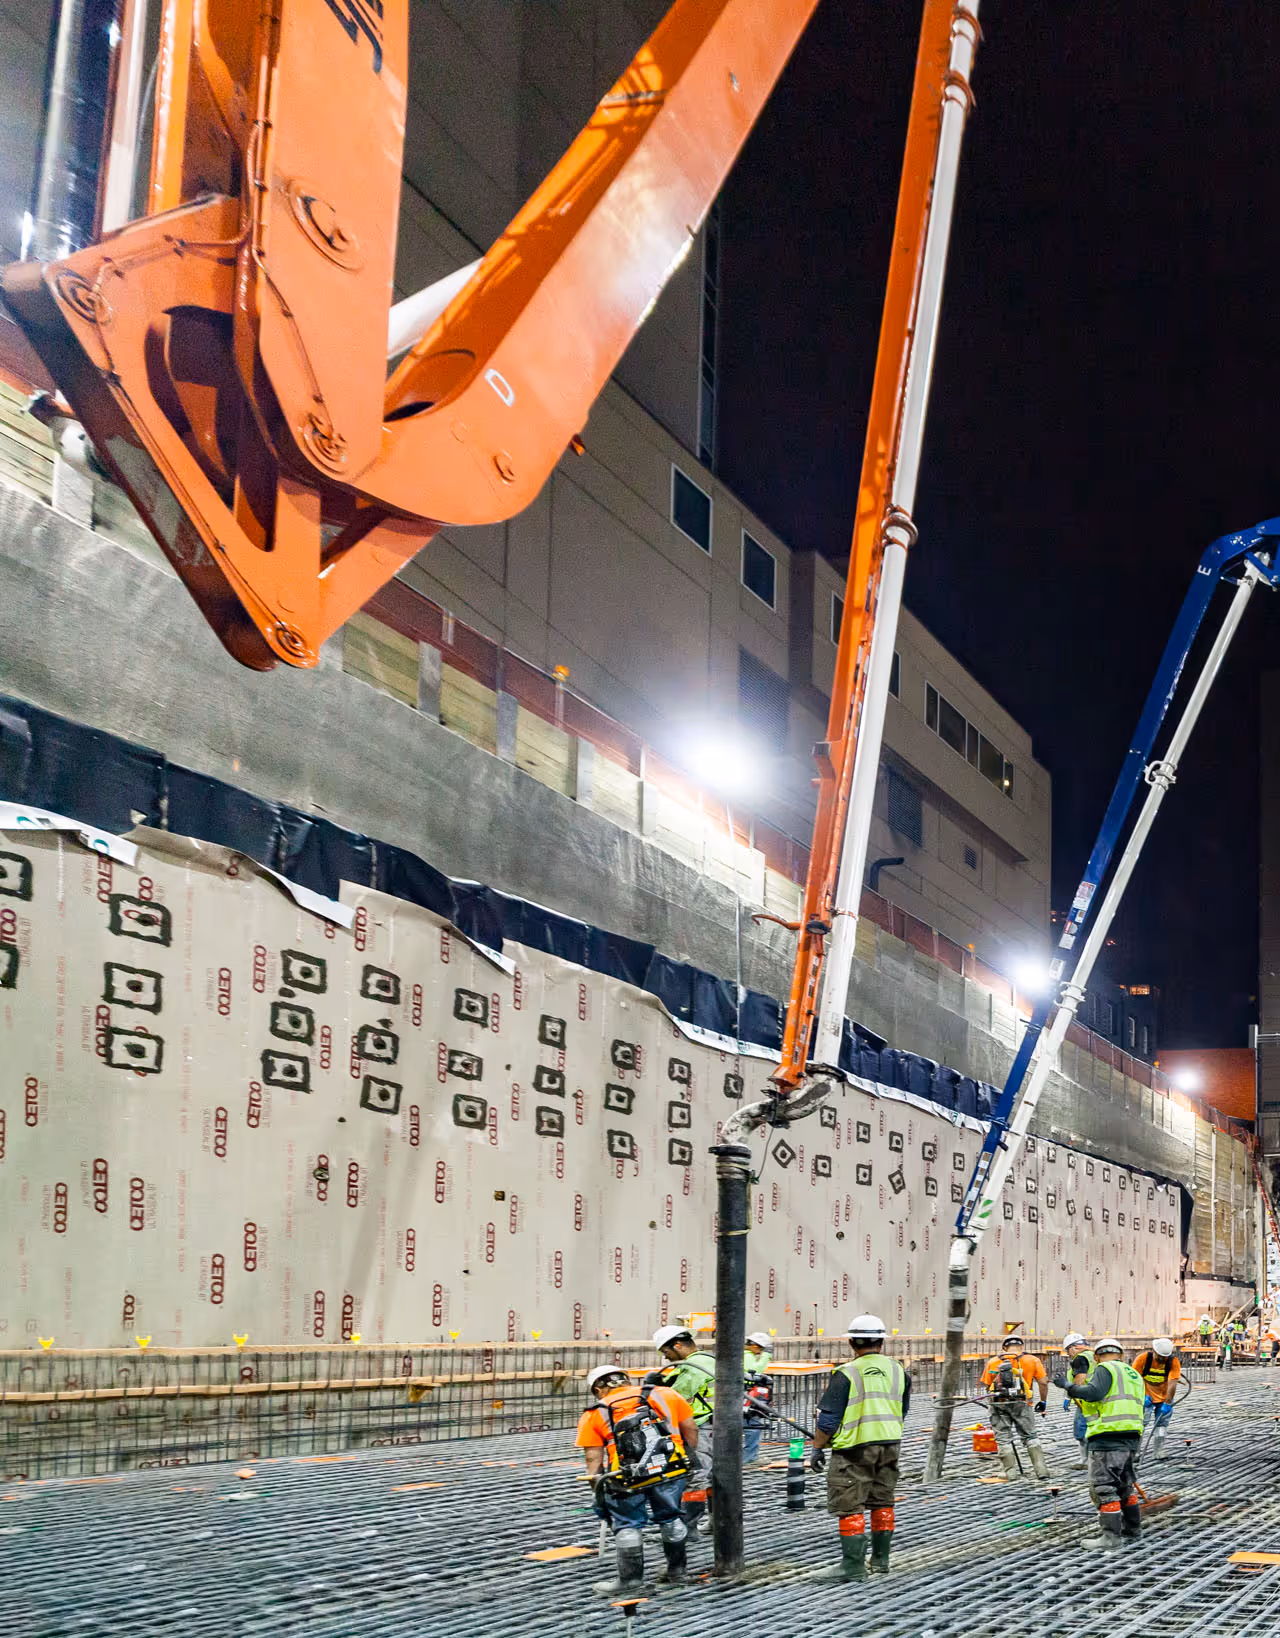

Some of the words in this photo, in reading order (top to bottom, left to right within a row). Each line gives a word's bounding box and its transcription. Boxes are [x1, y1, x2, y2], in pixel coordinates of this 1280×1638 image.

[1197, 564, 1212, 576] E
[97, 854, 115, 904] ETCO
[0, 908, 17, 943] TCO
[355, 906, 368, 953] CETCO
[253, 944, 268, 994] CETCO
[513, 970, 522, 1011] CETCO
[218, 967, 232, 1016] CETCO
[412, 983, 423, 1027] CETCO
[491, 993, 501, 1034] CETCO
[320, 1025, 332, 1070] CETCO
[437, 1042, 448, 1083] CETCO
[25, 1077, 38, 1127] CETCO
[247, 1081, 262, 1129] CETCO
[511, 1082, 520, 1121] CETCO
[575, 1089, 584, 1126] CETCO
[214, 1106, 229, 1158] CETCO
[409, 1105, 421, 1147] CETCO
[488, 1106, 498, 1146] CETCO
[434, 1160, 446, 1204] CETCO
[555, 1141, 564, 1179] CETCO
[54, 1182, 68, 1233] CETCO
[93, 1158, 109, 1213] CETCO
[130, 1177, 145, 1231] CETCO
[347, 1162, 360, 1209] CETCO
[509, 1195, 518, 1234] CETCO
[574, 1193, 583, 1232] CETCO
[244, 1222, 258, 1273] CETCO
[405, 1228, 416, 1272] CETCO
[486, 1222, 496, 1264] CETCO
[211, 1253, 225, 1305] CETCO
[554, 1250, 563, 1289] CETCO
[123, 1294, 135, 1331] ETCO
[314, 1290, 326, 1338] CETCO
[341, 1294, 354, 1342] CETCO
[432, 1284, 442, 1328] CETCO
[574, 1302, 582, 1341] CETCO
